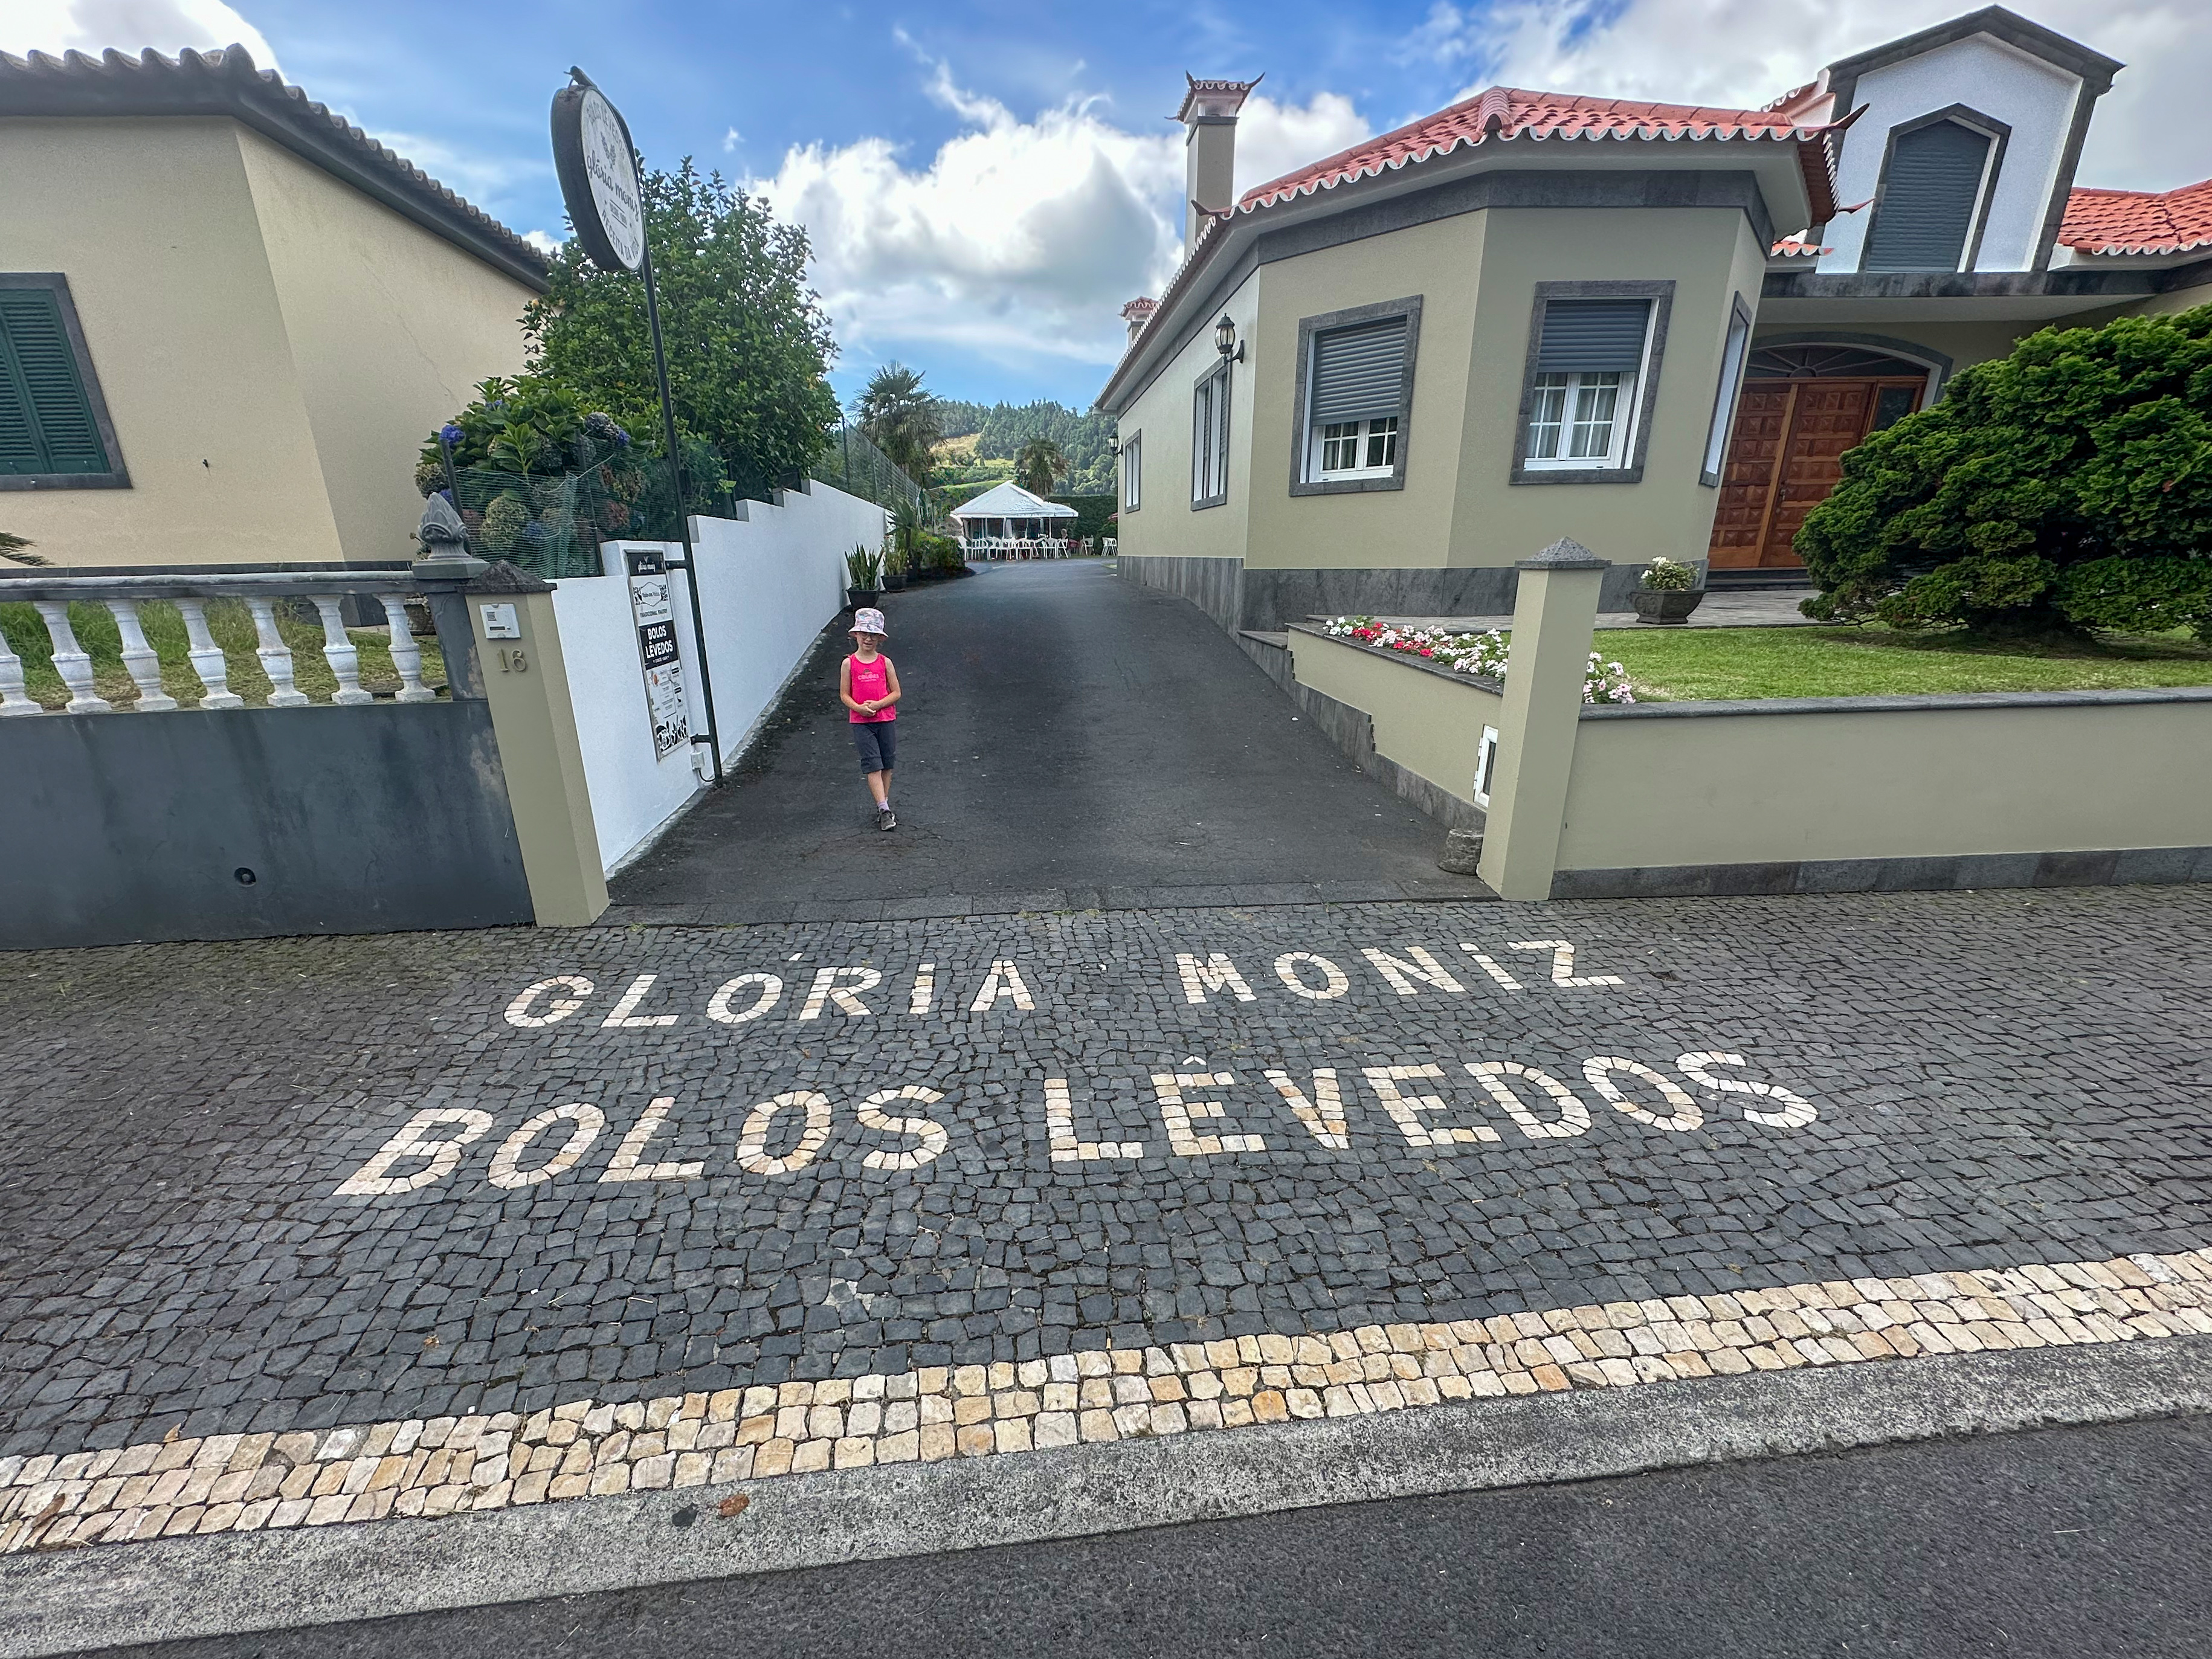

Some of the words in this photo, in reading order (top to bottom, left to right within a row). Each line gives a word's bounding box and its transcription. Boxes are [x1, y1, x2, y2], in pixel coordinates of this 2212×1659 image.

[587, 149, 613, 192] glória
[614, 182, 639, 222] moniz
[602, 208, 624, 257] RECEITA
[645, 639, 673, 659] LÊVEDOS
[647, 625, 666, 640] BOLOS
[497, 648, 527, 672] 16
[333, 1084, 948, 1196] BOLOS
[1044, 1051, 1819, 1162] LÊVEDOS
